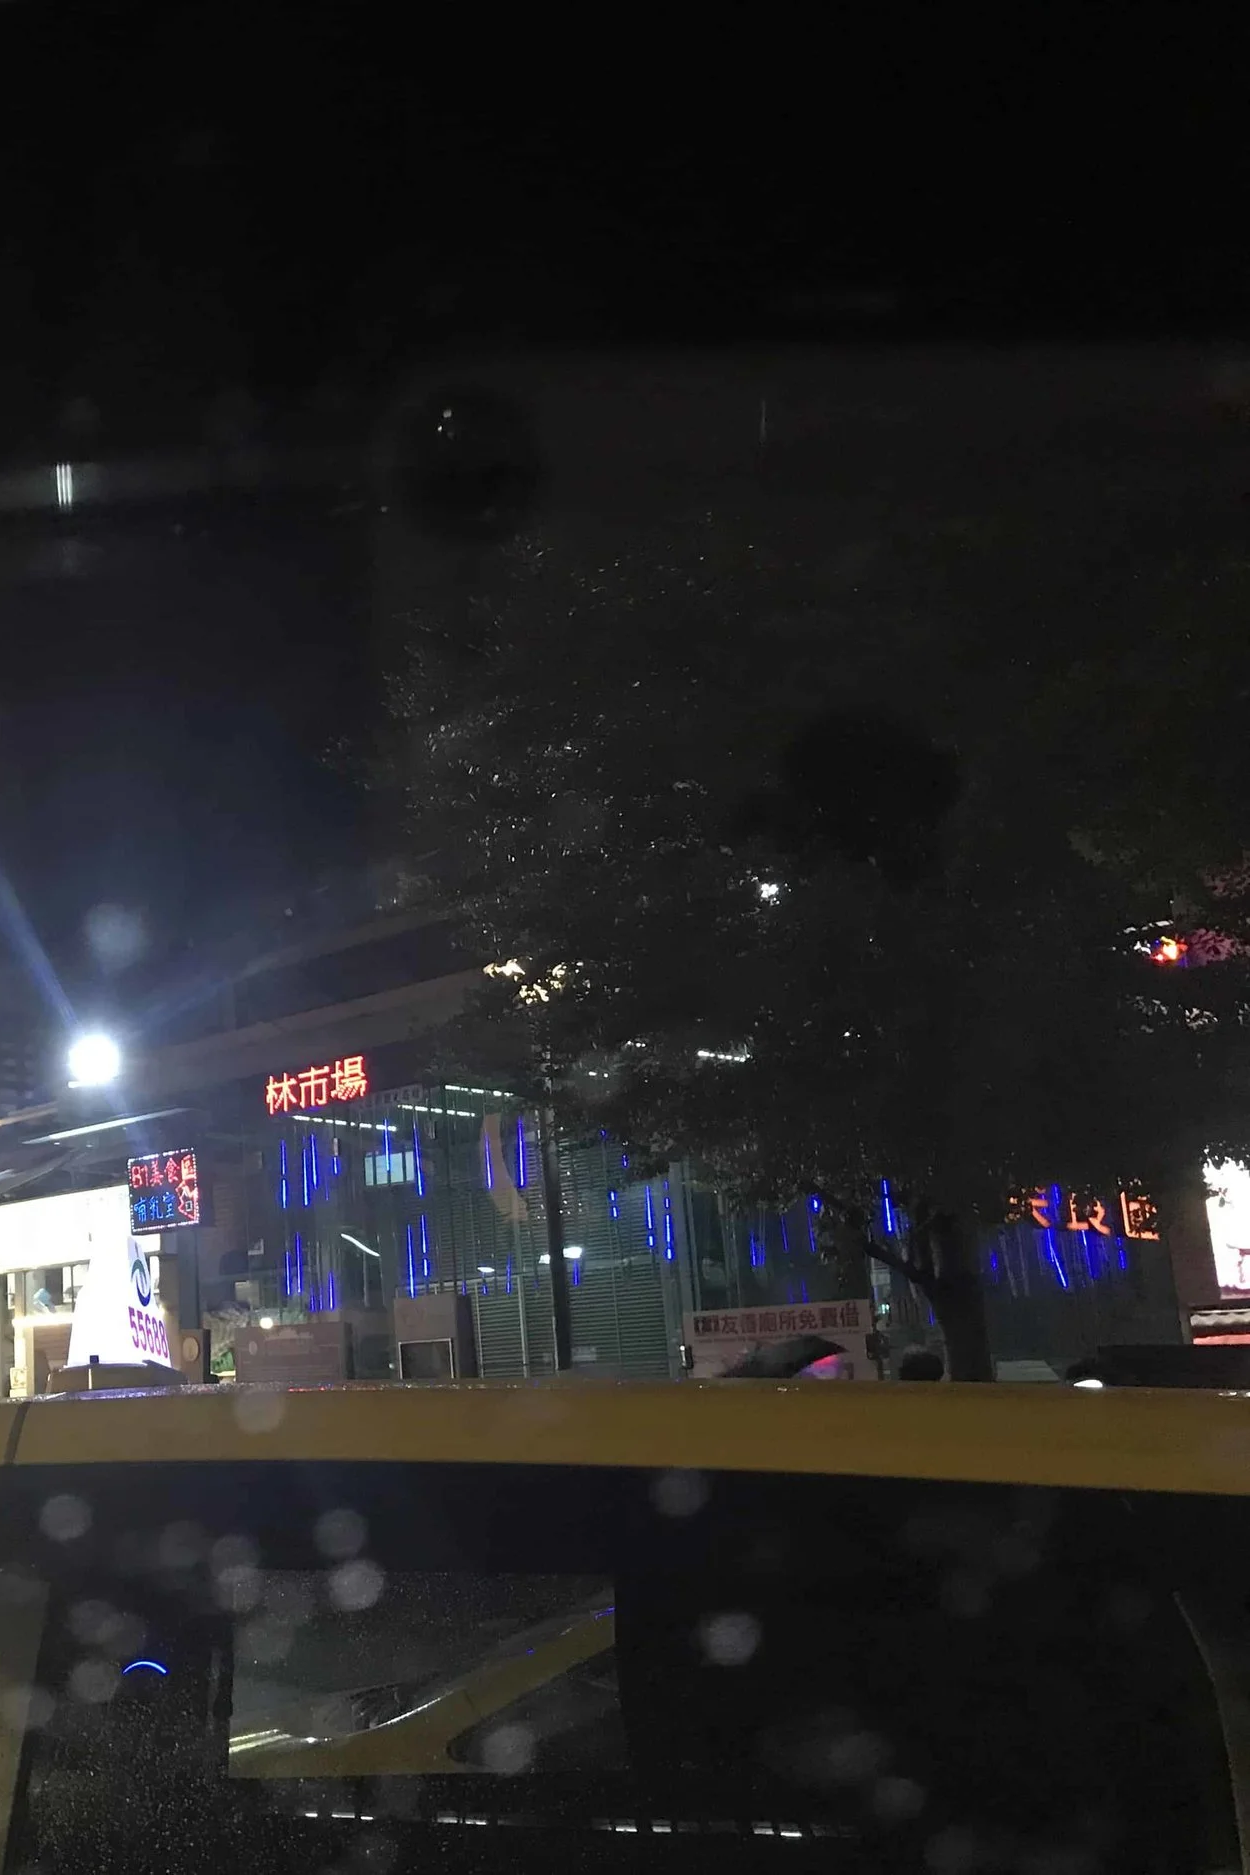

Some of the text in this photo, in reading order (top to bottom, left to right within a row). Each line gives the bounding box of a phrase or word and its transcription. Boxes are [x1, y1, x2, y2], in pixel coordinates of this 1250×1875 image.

[266, 1055, 368, 1115] 林市場
[128, 1306, 168, 1359] 55688
